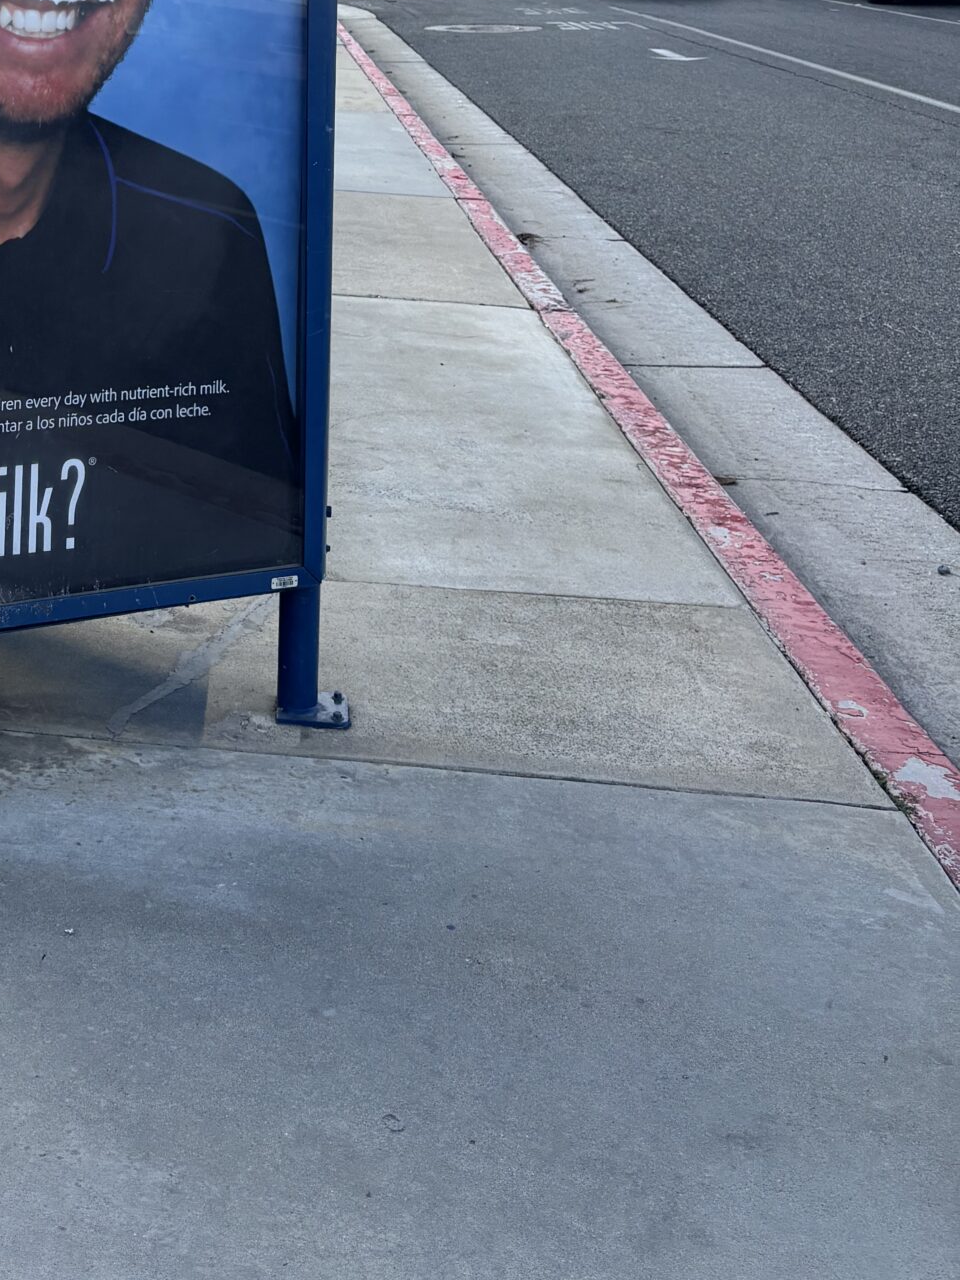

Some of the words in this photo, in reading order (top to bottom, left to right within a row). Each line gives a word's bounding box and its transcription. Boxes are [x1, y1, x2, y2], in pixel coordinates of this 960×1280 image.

[25, 395, 62, 411] every
[63, 390, 88, 409] day
[89, 387, 118, 404] with
[120, 381, 197, 401] nutrient-rich
[199, 379, 230, 396] milk.
[25, 420, 34, 431] a
[36, 415, 56, 431] los
[58, 412, 93, 429] niños
[95, 408, 125, 425] cada
[127, 406, 147, 422] día
[149, 408, 173, 421] con
[175, 402, 212, 419] leche.
